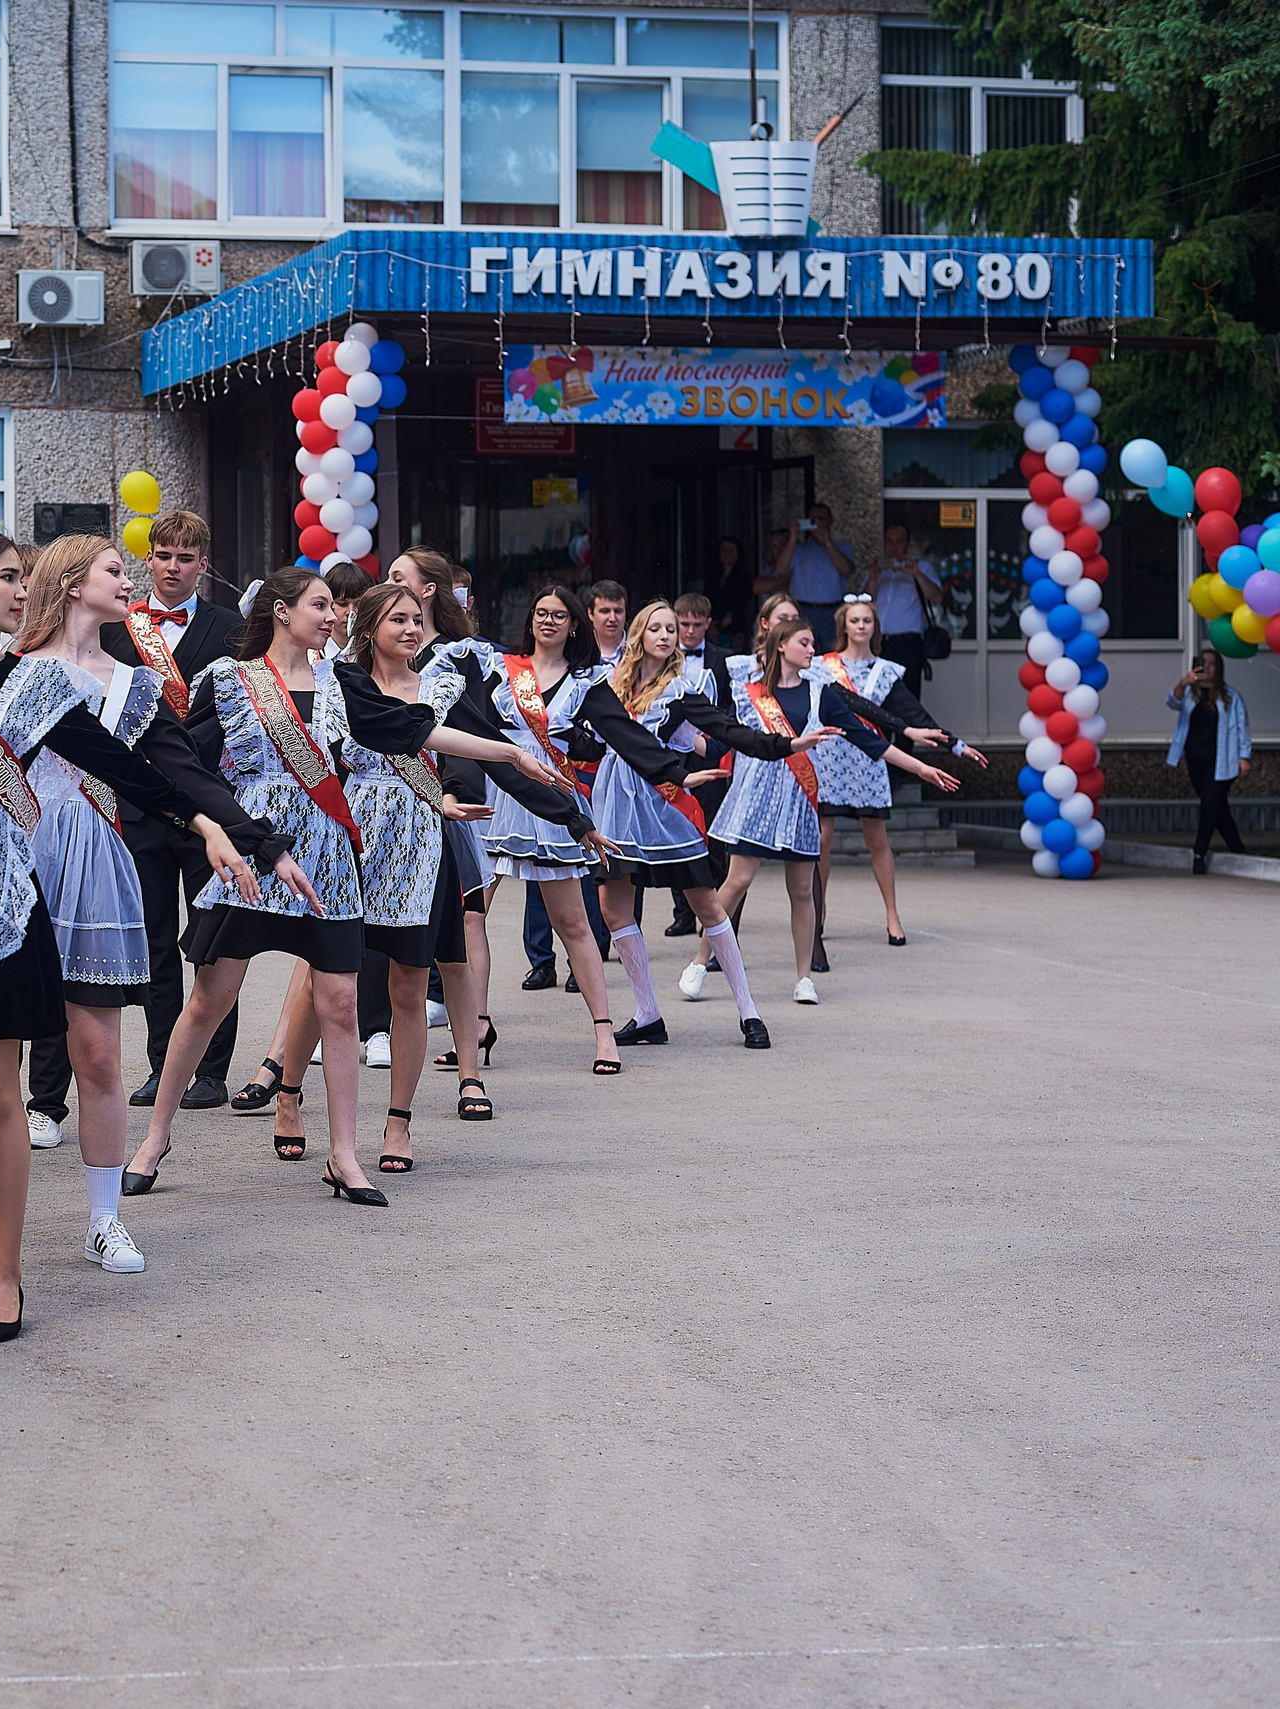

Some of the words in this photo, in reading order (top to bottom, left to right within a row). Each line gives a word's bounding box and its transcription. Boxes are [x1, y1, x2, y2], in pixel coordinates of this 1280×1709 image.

[470, 246, 846, 299] ГИМНАЗИЯ
[604, 359, 659, 384] Наш
[664, 357, 791, 390] последний
[678, 384, 852, 419] ЗВОНОК
